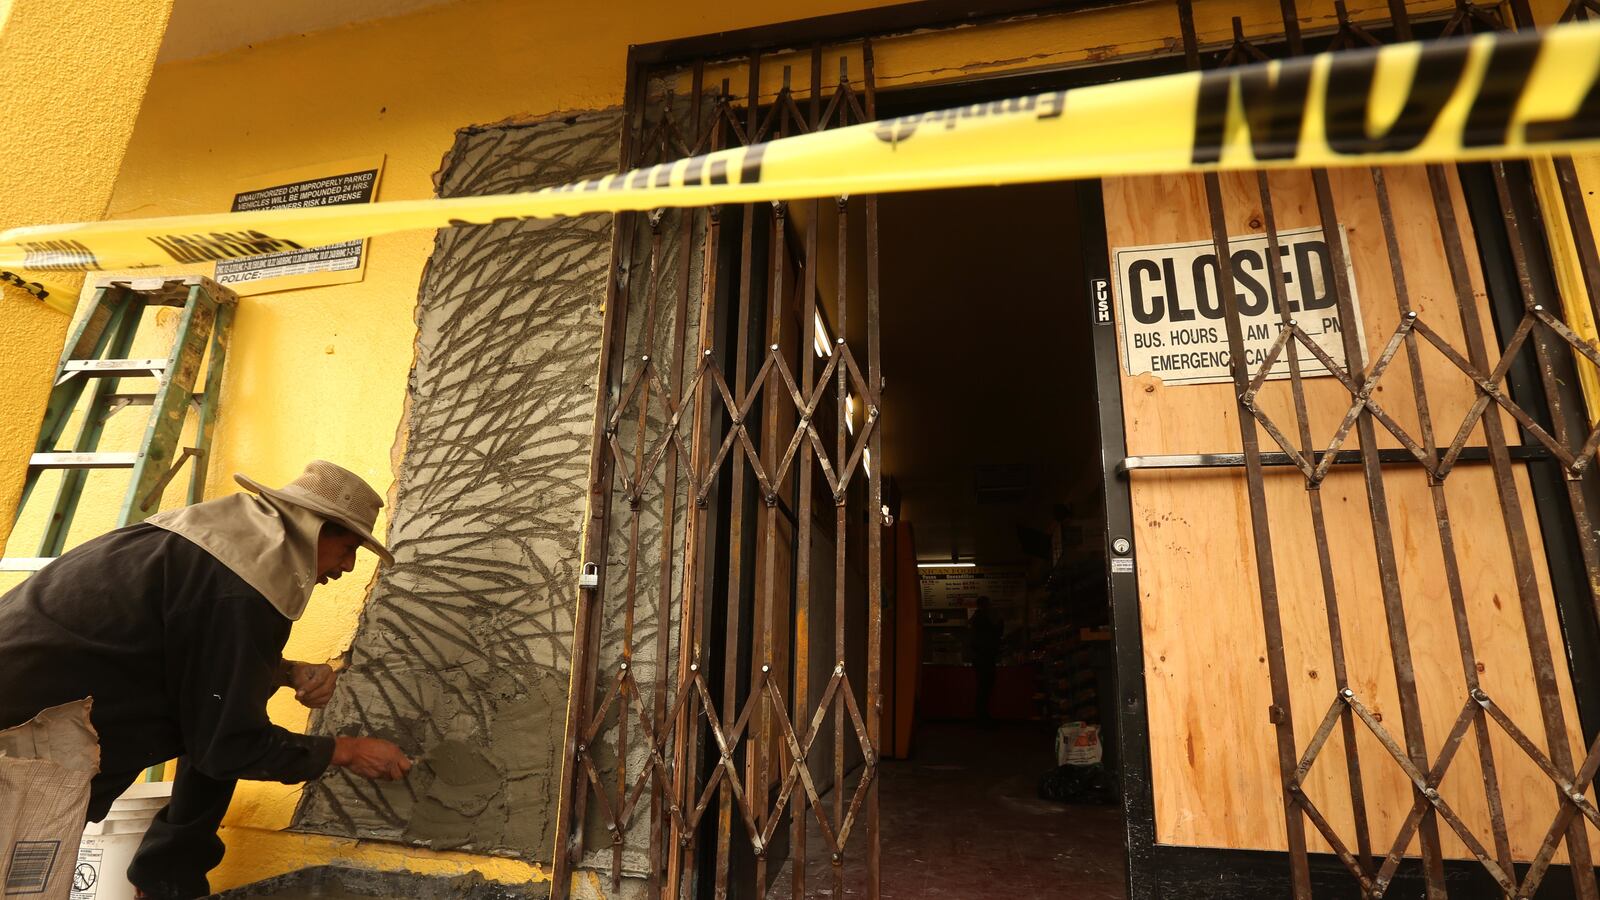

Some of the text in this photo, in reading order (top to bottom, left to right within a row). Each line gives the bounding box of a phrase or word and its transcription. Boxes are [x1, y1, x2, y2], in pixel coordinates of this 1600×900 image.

[237, 198, 271, 210] VEHICLES
[271, 196, 288, 205] WILL
[288, 193, 300, 202] BE
[299, 186, 343, 200] IMPOUNDED
[342, 184, 352, 193] 24
[351, 181, 370, 191] HRS.
[238, 173, 373, 203] UNAUTHORIZED OR IMPROPERLY PARKED
[302, 198, 321, 209] RISK
[320, 197, 327, 205] &
[327, 190, 362, 204] EXPENSE
[220, 270, 263, 284] POLICE:
[1128, 240, 1338, 325] CLOSED
[1096, 281, 1110, 322] PUSH
[1134, 331, 1166, 350] BUS.
[1170, 327, 1218, 347] HOURS
[1247, 323, 1270, 341] AM
[1151, 350, 1233, 372] EMERGENC
